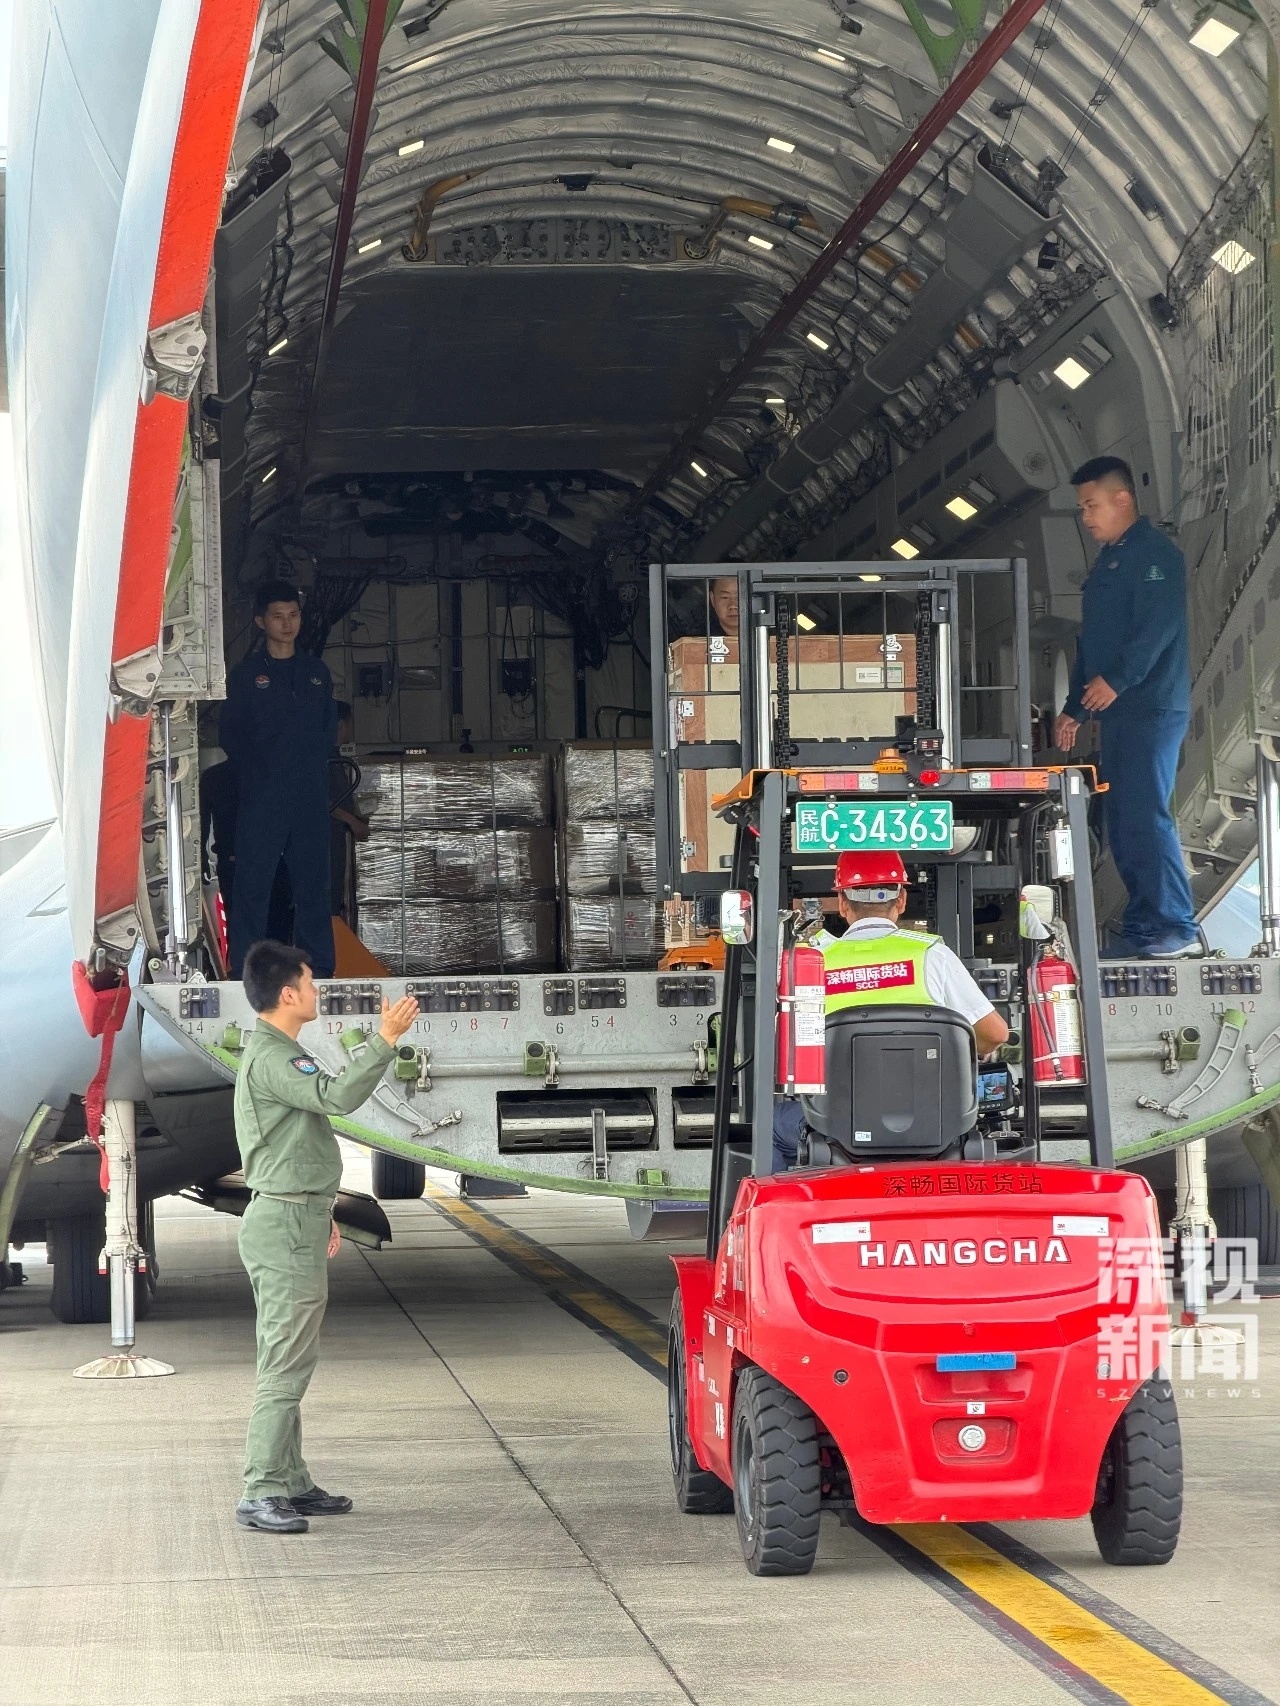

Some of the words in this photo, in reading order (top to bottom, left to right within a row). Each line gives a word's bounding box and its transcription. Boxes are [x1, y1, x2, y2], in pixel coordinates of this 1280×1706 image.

[800, 809, 820, 843] 民航
[820, 808, 948, 843] C-34363
[826, 962, 908, 986] 深畅国际货站
[855, 980, 880, 990] SCCT
[1108, 1003, 1117, 1016] 8
[1130, 1003, 1138, 1017] 9
[1156, 1003, 1173, 1016] 10
[1240, 1000, 1256, 1014] 12
[414, 1020, 431, 1034] 10
[450, 1019, 458, 1033] 9
[470, 1017, 479, 1031] 8
[500, 1017, 509, 1030] 7
[591, 1015, 599, 1028] 5
[606, 1015, 616, 1028] 4
[669, 1014, 678, 1027] 3
[695, 1013, 704, 1026] 2
[188, 1020, 204, 1035] 14
[327, 1021, 344, 1035] 12
[555, 1022, 564, 1035] 6
[884, 1172, 1043, 1197] 深畅国际货站
[859, 1238, 1071, 1267] HANGCHA
